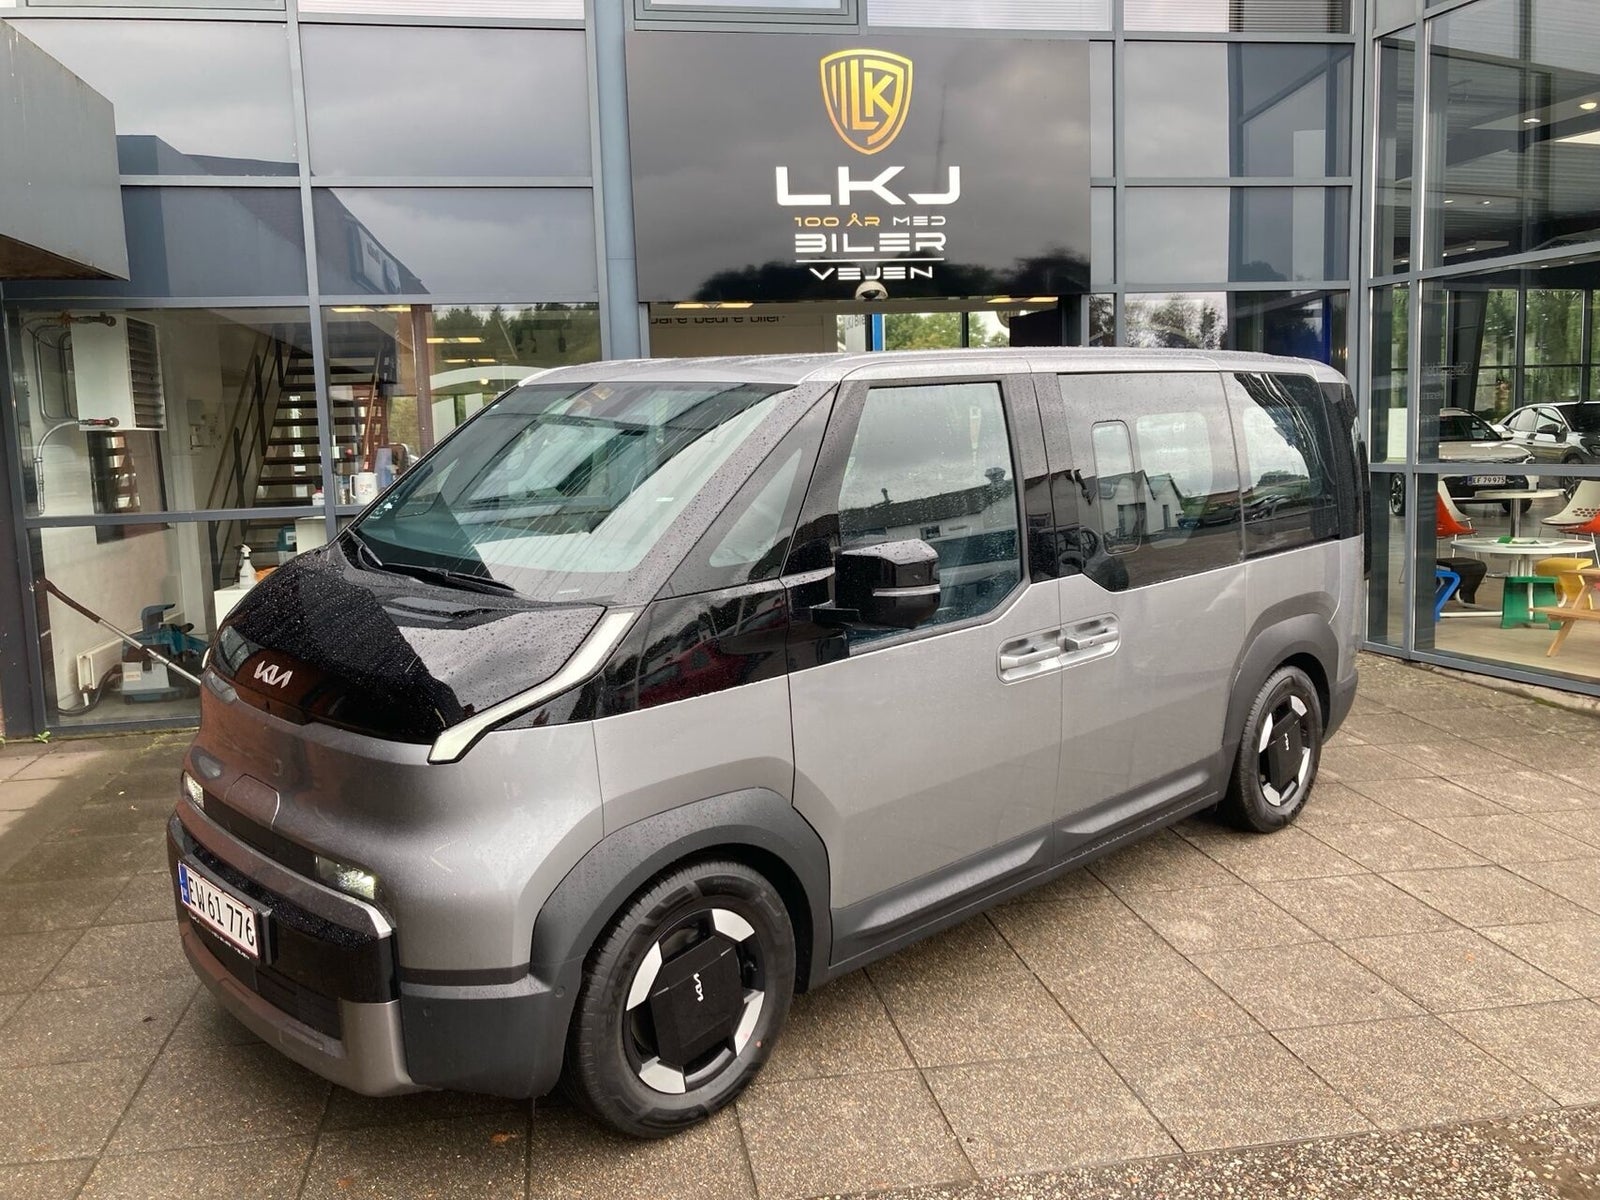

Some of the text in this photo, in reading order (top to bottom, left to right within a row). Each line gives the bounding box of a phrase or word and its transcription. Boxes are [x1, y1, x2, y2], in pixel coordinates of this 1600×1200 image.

[776, 166, 960, 206] LKJ
[794, 212, 946, 227] 100 ÅR MED
[795, 232, 947, 253] BILER
[809, 266, 933, 281] VEJEN
[253, 660, 293, 688] KIA
